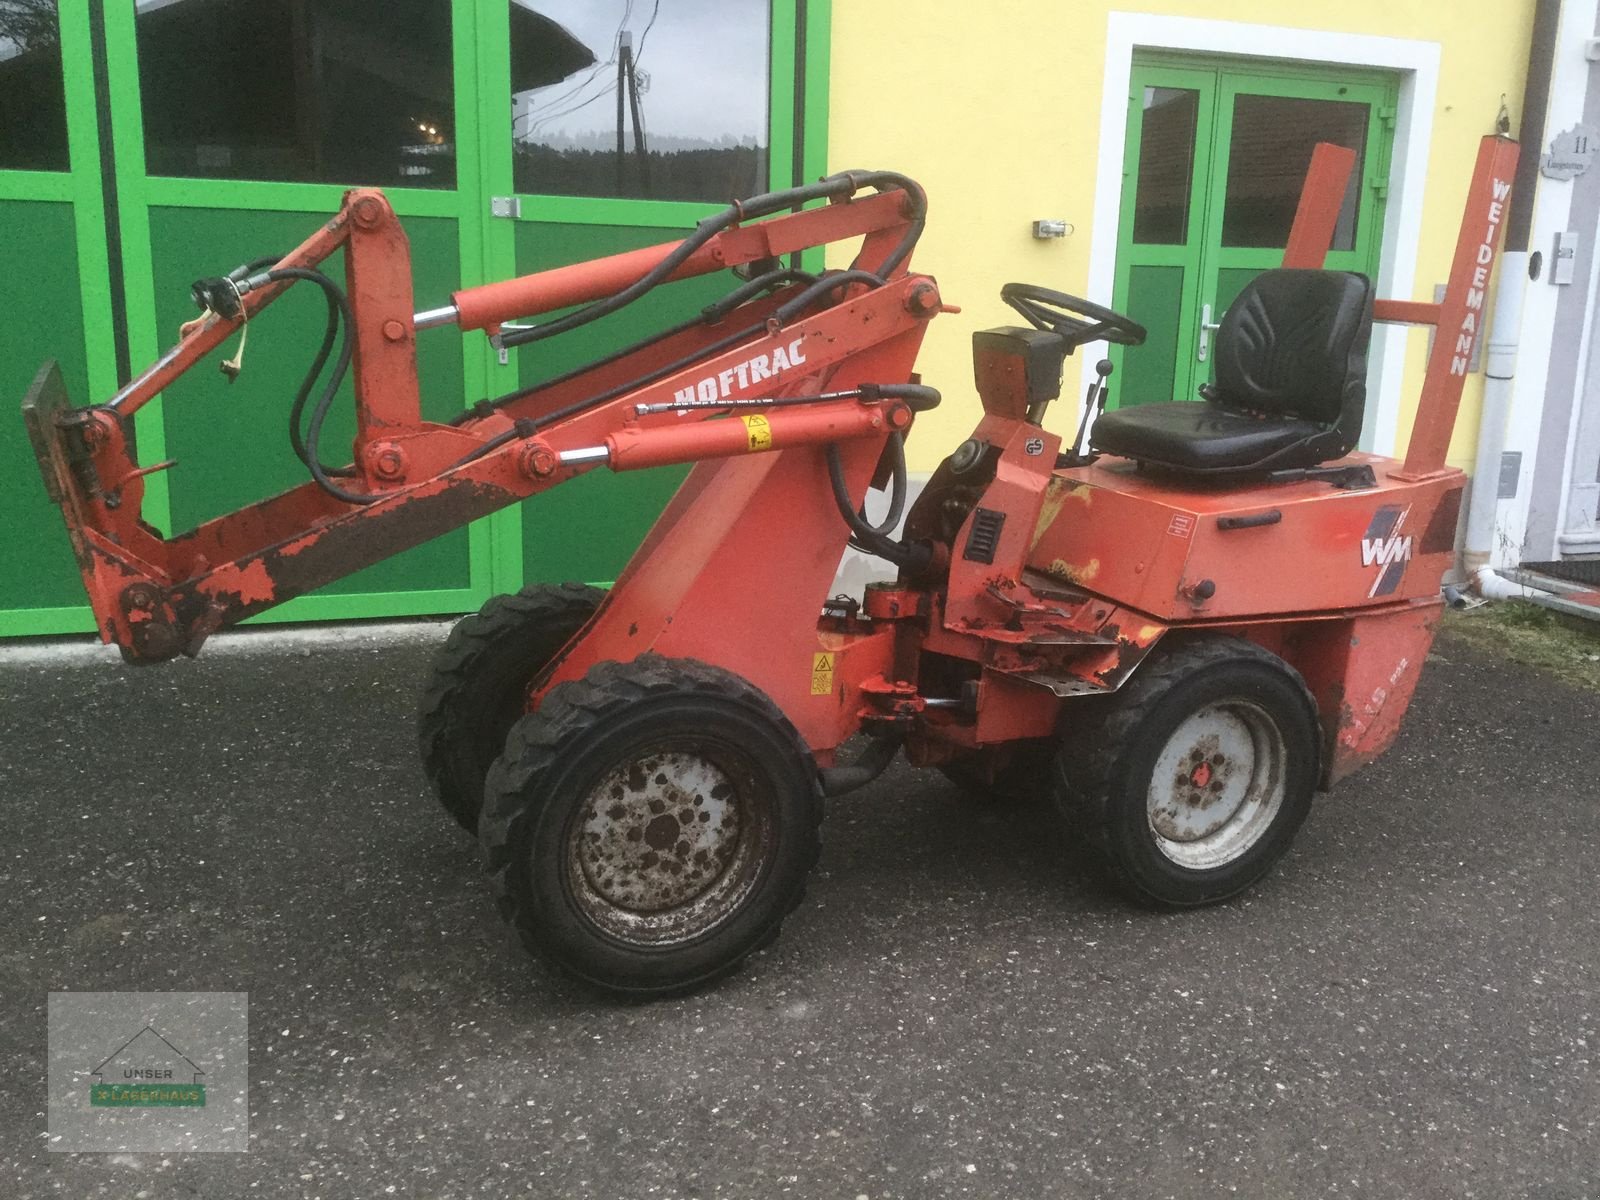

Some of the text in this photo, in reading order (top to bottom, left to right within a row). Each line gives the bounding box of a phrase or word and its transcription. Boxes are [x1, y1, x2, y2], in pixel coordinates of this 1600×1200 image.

[1572, 136, 1588, 154] 11
[1450, 177, 1511, 377] WEIDEMANN
[673, 337, 807, 417] HOFTRAC
